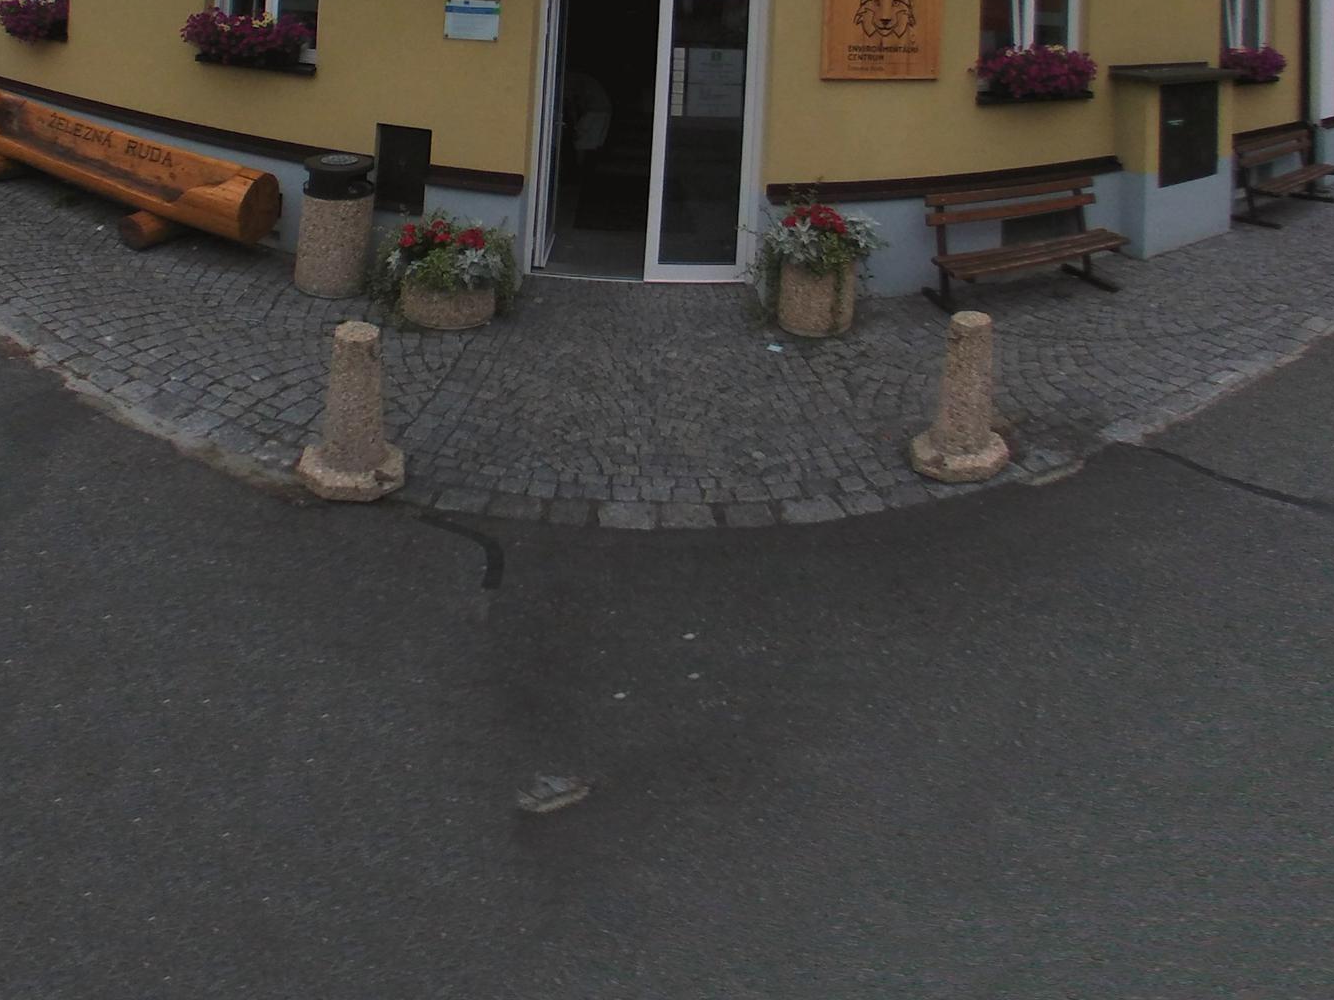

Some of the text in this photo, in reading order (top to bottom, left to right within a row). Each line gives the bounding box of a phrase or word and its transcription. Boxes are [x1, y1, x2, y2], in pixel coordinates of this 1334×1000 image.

[847, 53, 885, 61] CENTRUM
[48, 112, 173, 167] ŽELEZNÁ RUDA
